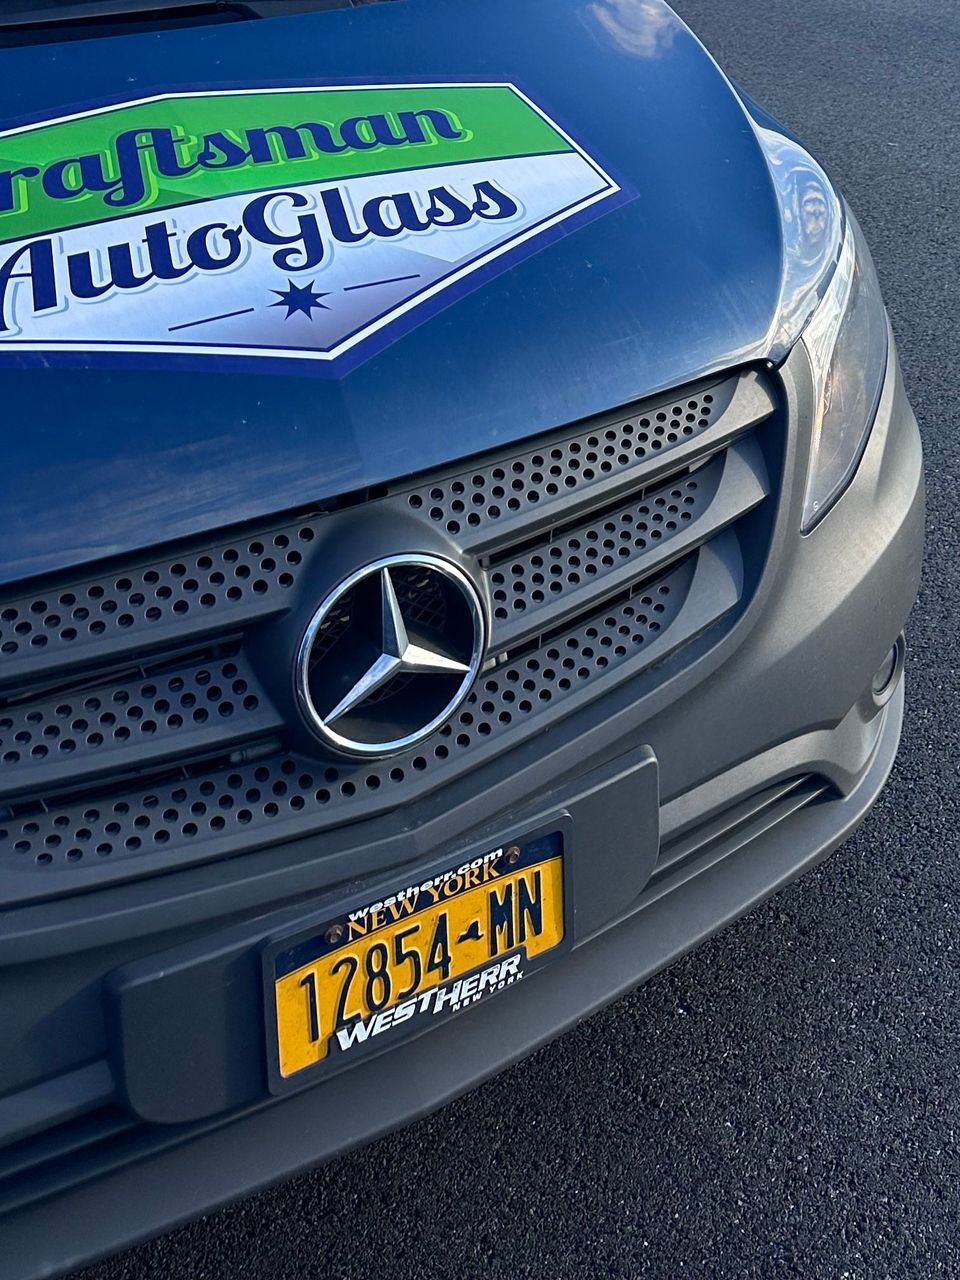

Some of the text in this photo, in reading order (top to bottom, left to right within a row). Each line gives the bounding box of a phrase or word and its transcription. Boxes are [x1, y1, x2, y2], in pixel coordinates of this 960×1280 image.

[0, 107, 466, 211] raftsman
[0, 180, 520, 331] AutoGlass
[347, 858, 501, 942] NEW YORK
[348, 847, 503, 922] westherr.com
[300, 912, 453, 1043] 12854
[336, 953, 522, 1052] WESTHERR
[452, 970, 524, 1013] NEW YORK
